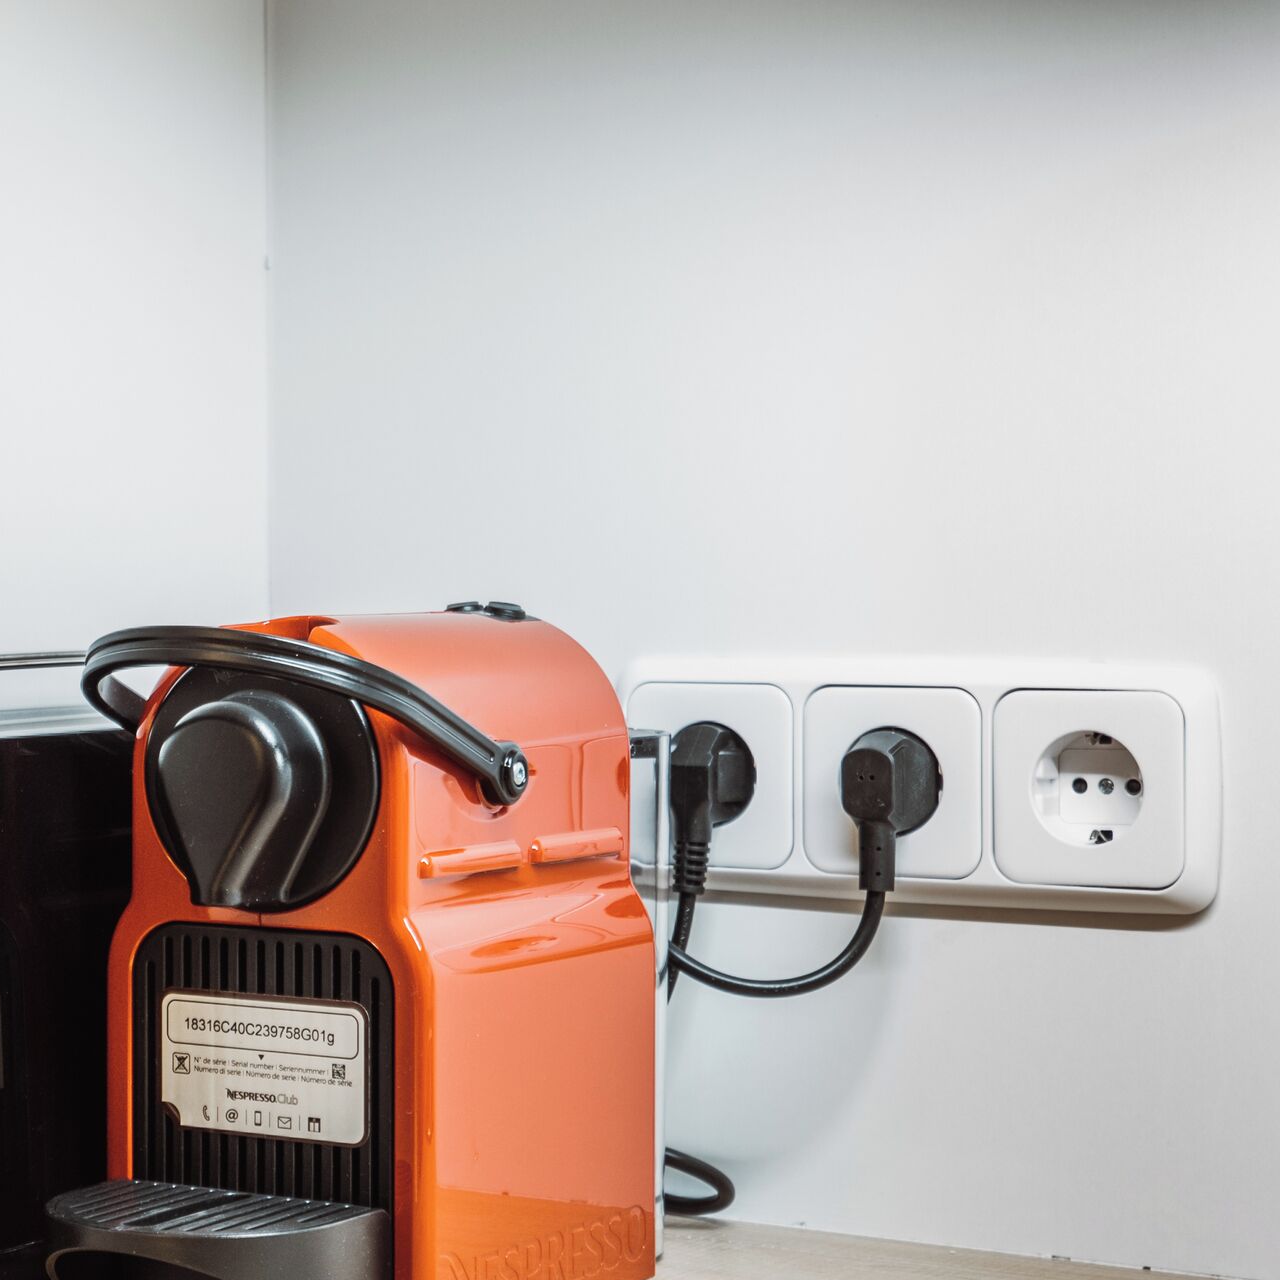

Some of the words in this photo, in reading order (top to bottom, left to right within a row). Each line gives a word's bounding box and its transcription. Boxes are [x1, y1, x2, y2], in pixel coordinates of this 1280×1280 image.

[184, 1017, 335, 1046] 18316C40C239758G01g
[231, 1059, 248, 1068] Serial
[249, 1062, 274, 1071] number
[278, 1064, 326, 1075] Seriennummer
[327, 1078, 336, 1086] de
[277, 1093, 299, 1106] Club
